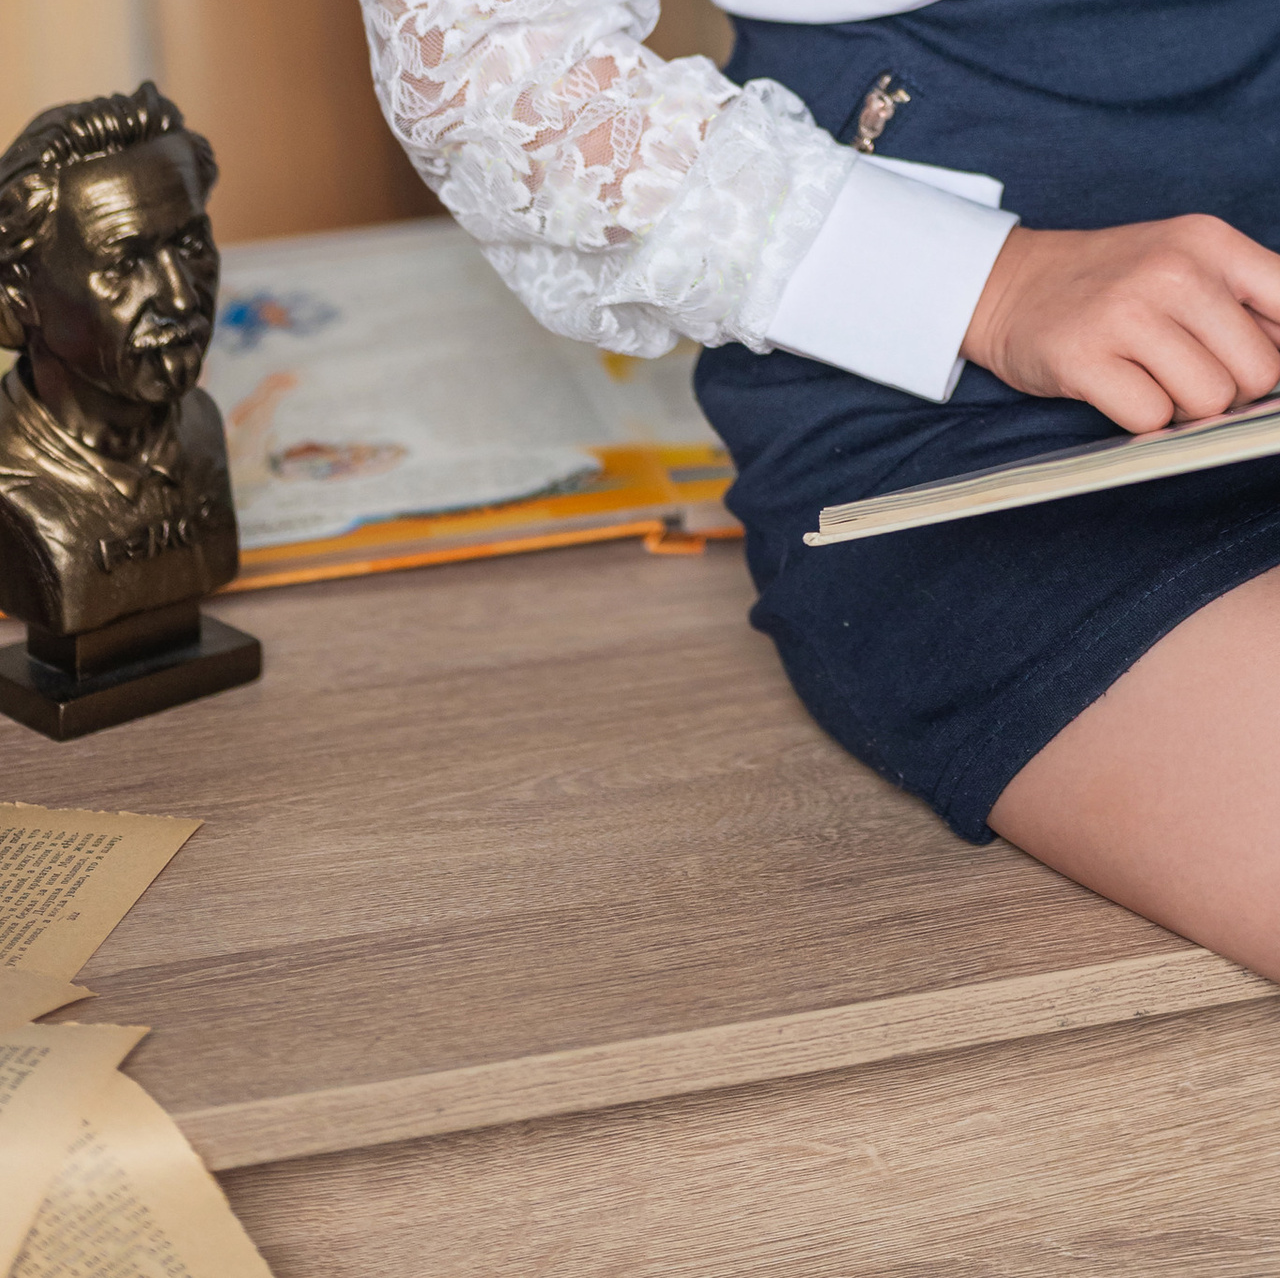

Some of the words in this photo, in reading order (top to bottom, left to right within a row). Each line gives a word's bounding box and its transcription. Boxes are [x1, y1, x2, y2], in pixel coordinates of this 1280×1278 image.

[9, 841, 32, 861] видел,
[27, 829, 41, 839] что
[30, 841, 45, 851] что
[63, 874, 91, 898] увидел,
[84, 861, 99, 872] что
[100, 835, 123, 854] плачу,
[10, 875, 31, 894] мной,
[32, 849, 53, 868] потом
[14, 892, 31, 907] стал
[26, 865, 59, 891] кричать
[15, 900, 39, 920] бежал
[45, 871, 63, 886] ним.
[57, 855, 76, 868] Мне
[72, 833, 94, 852] жалко
[32, 888, 64, 916] Дедушка
[60, 856, 90, 885] подошел,
[91, 834, 108, 848] взял
